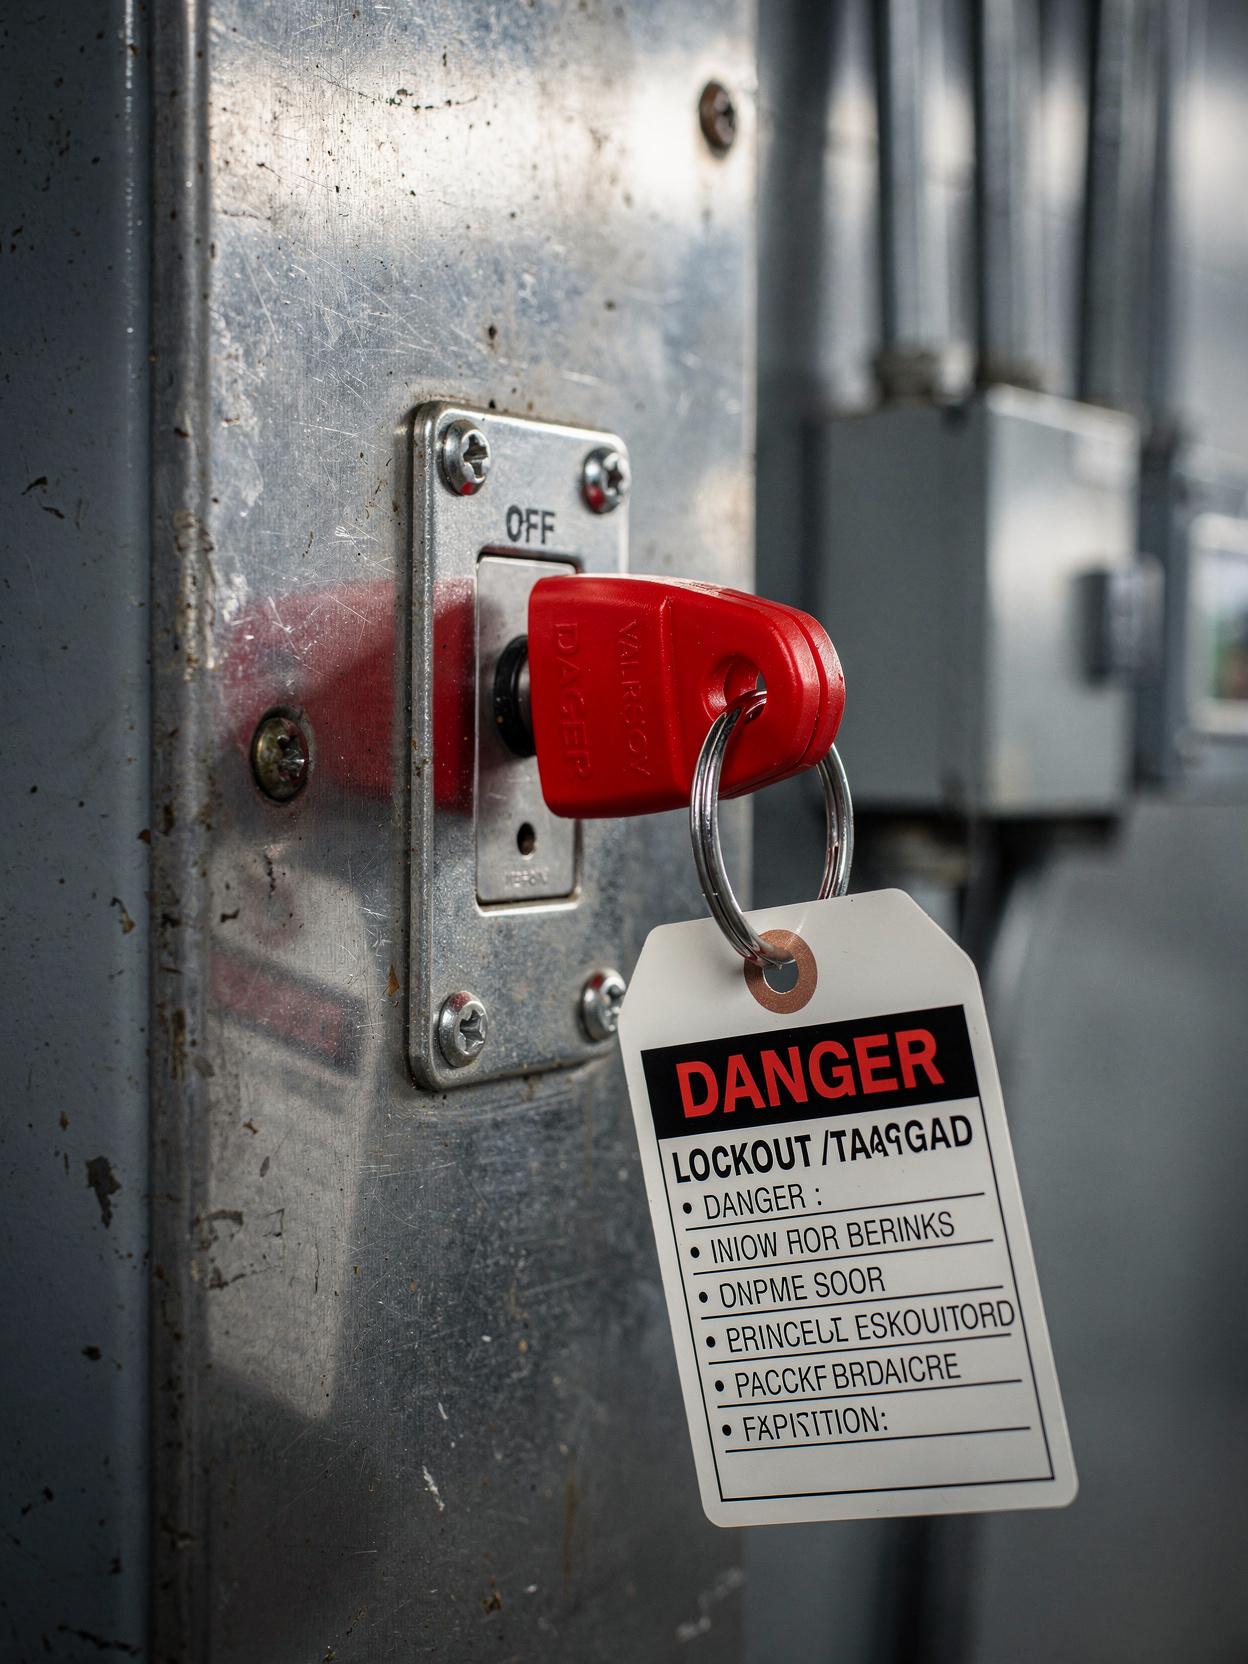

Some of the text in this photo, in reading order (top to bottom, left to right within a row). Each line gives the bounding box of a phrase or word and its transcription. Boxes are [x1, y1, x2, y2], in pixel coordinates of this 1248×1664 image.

[505, 504, 556, 545] OFF
[675, 1028, 945, 1119] DANGER
[671, 1134, 812, 1184] LOCKOUT
[703, 1183, 806, 1221] DANGER
[846, 1210, 956, 1249] BERINKS
[814, 1266, 886, 1299] SOOR
[833, 1352, 961, 1390] BRDAICRE
